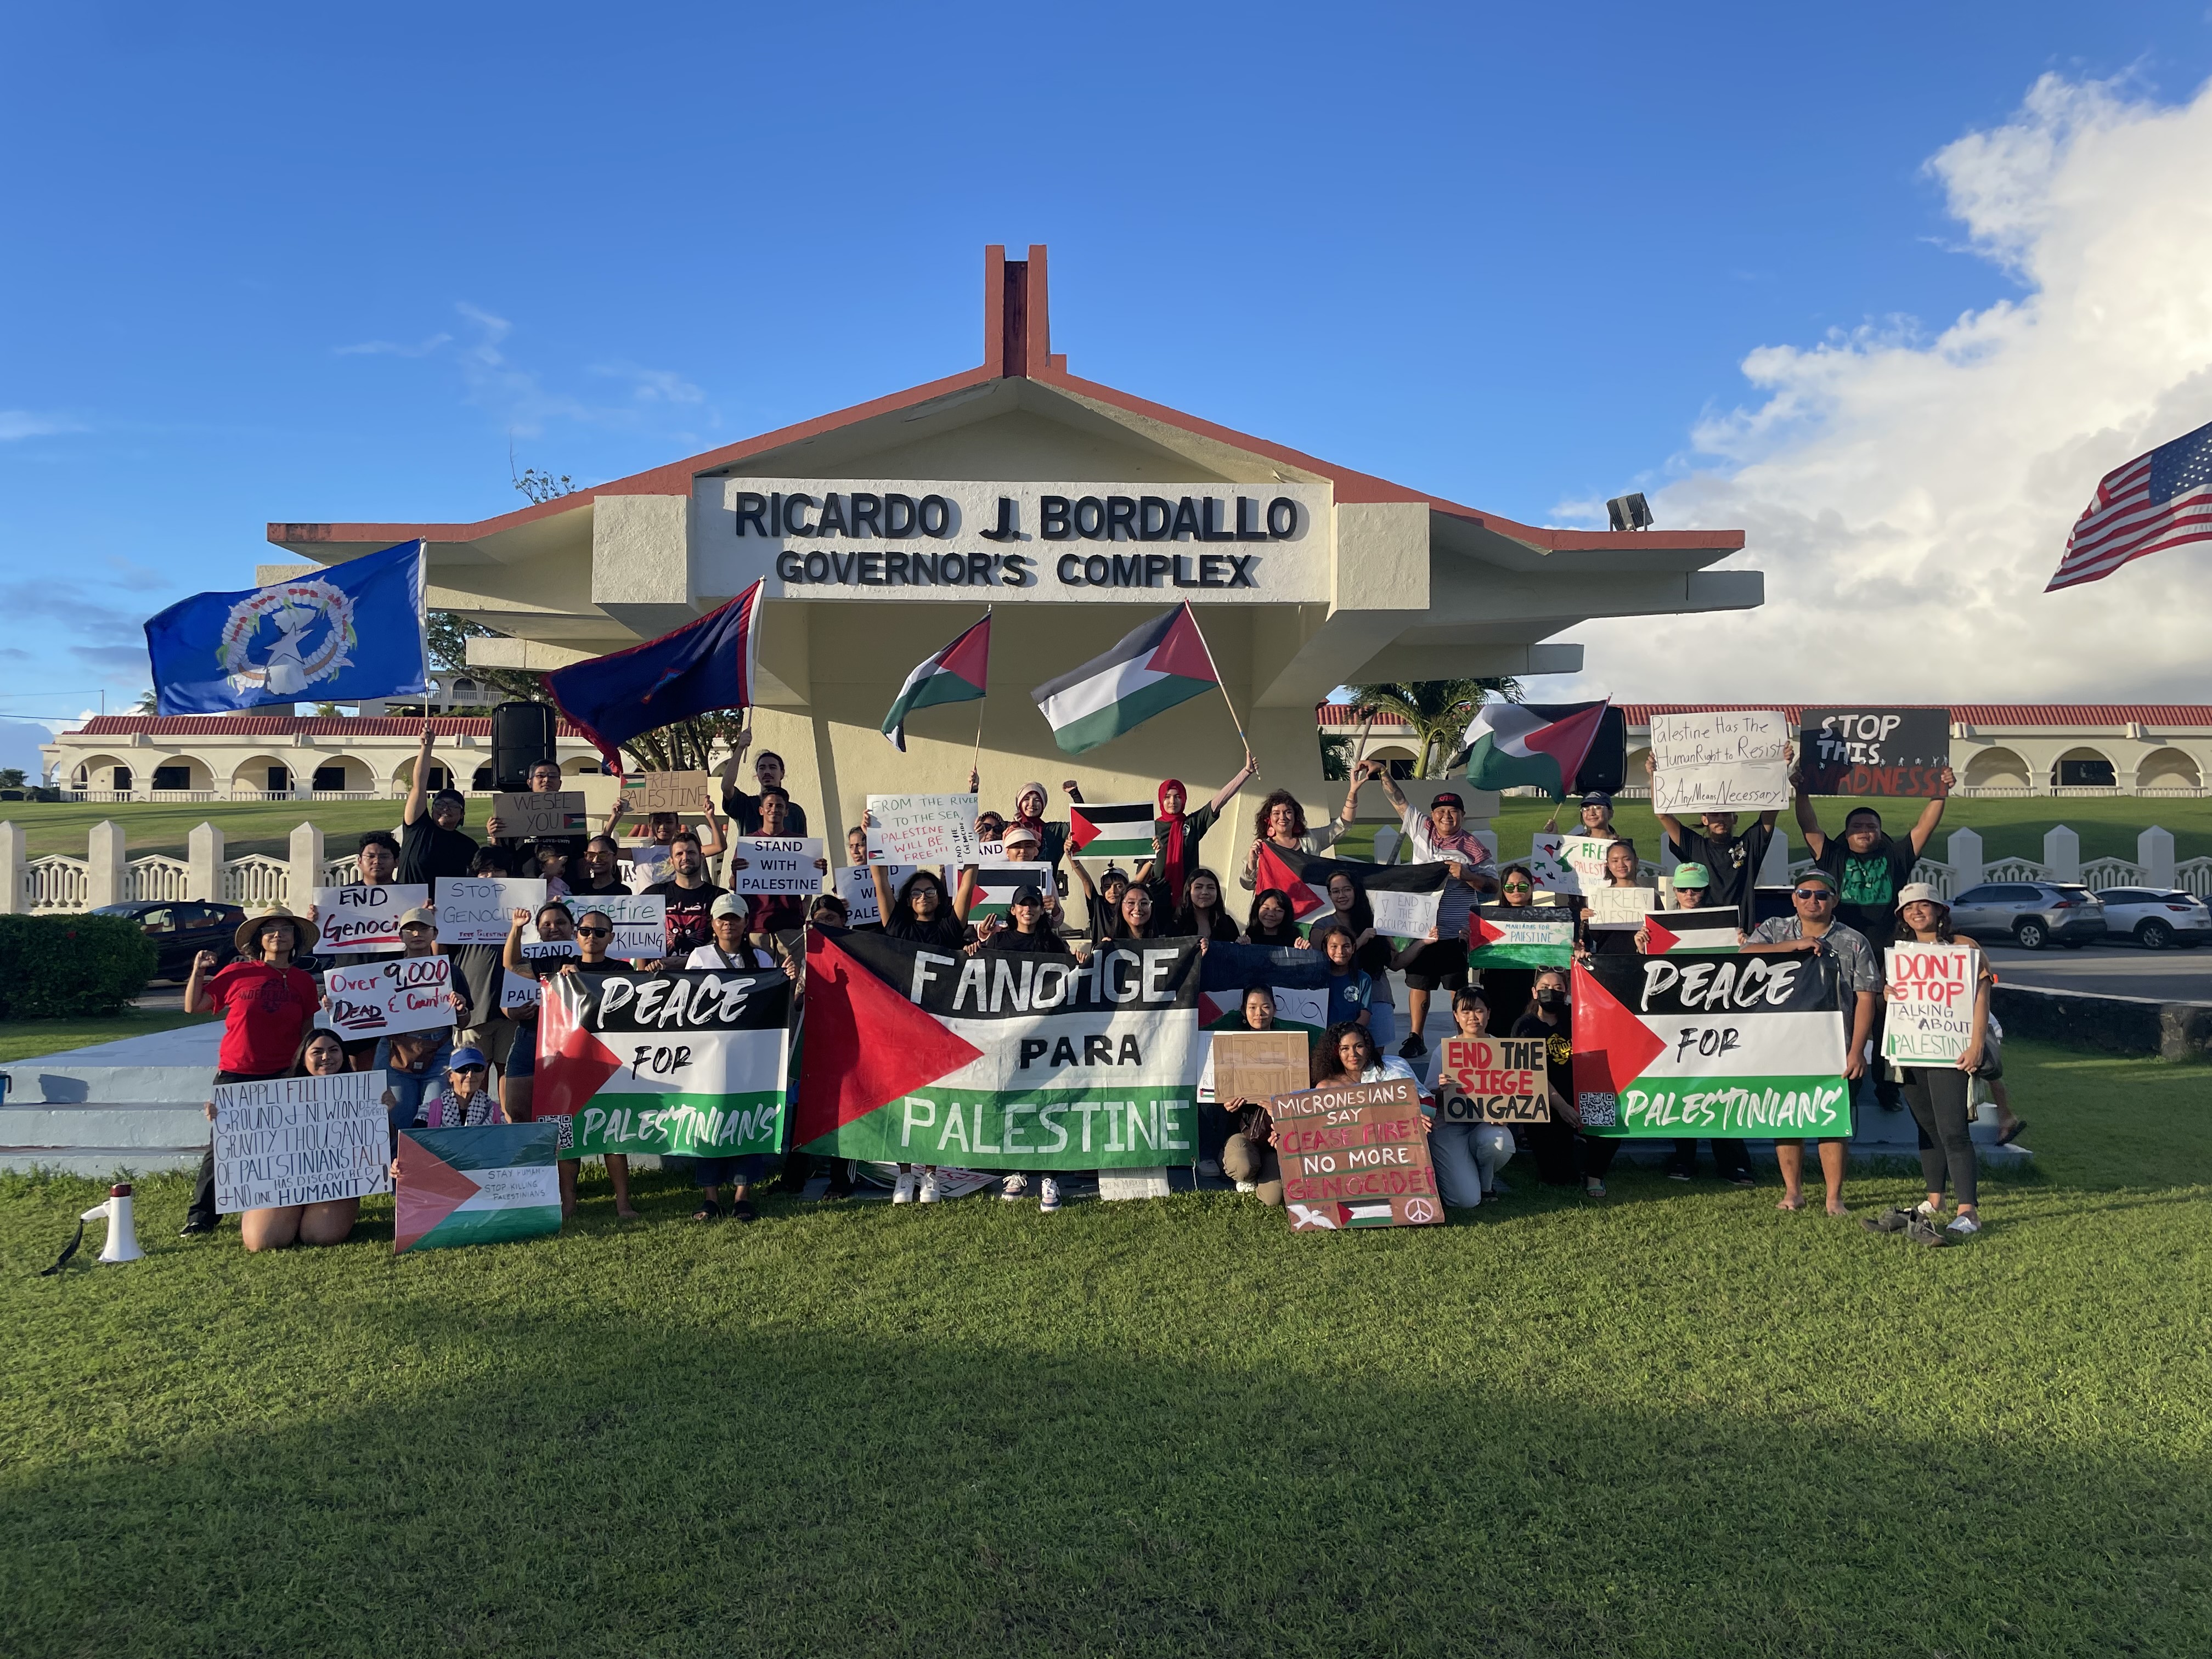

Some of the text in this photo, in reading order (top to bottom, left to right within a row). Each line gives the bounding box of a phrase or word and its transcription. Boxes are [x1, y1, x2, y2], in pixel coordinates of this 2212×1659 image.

[736, 492, 1297, 540] RICARDO J. BORDALLO
[776, 550, 1251, 586] GOVERNOR'S COMPLEX
[1652, 716, 1769, 744] Palestine Has The
[1819, 714, 1901, 741] STOP
[1655, 736, 1786, 769] Human Right to Resist
[1816, 740, 1880, 765] THIS
[645, 772, 679, 788] FREE
[1812, 765, 1948, 796] MADNESS!
[514, 793, 571, 811] WE SEE
[620, 786, 707, 808] PALESTINE
[1655, 776, 1674, 812] By
[1674, 778, 1692, 807] Any
[1692, 783, 1717, 802] Means
[872, 797, 978, 815] FROM THE RIVER
[526, 812, 559, 832] YOU
[891, 811, 963, 827] TO THE SEA,
[755, 840, 803, 851] STAND
[881, 826, 945, 844] PALESTINE
[894, 835, 944, 853] WILL BE
[951, 827, 964, 864] END THE
[1582, 843, 1609, 860] FRE
[760, 860, 797, 870] WITH
[854, 865, 899, 880] STD
[450, 883, 507, 898] STOP
[742, 879, 818, 890] PALESTINE
[340, 888, 388, 907] END
[1398, 895, 1419, 906] END
[1601, 889, 1642, 909] FREE
[563, 899, 656, 920] Ceasefire
[1398, 908, 1414, 919] THE
[1591, 910, 1644, 926] PALESTIN
[323, 914, 399, 941] Genoci
[477, 929, 508, 938] PALESTINE
[1376, 918, 1432, 933] OCCUPATION
[1511, 931, 1554, 943] PALESTINE
[523, 945, 573, 958] STAND
[616, 932, 664, 953] KILLING
[331, 959, 449, 992] Over 9,000
[1895, 952, 1967, 980] DON'T
[1640, 957, 1802, 1012] PEACE
[1893, 981, 1965, 1008] STOP
[333, 1000, 382, 1023] DEAD
[596, 975, 756, 1029] PEACE
[1890, 1002, 1954, 1018] TALKING
[1918, 1017, 1971, 1034] ABOUT
[1020, 1035, 1142, 1069] PARA
[1449, 1041, 1544, 1071] END THE
[1677, 1028, 1741, 1064] FOR
[632, 1046, 693, 1080] FOR
[215, 1073, 379, 1109] AN APPLE FELL TO THE
[1456, 1069, 1533, 1095] SIEGE
[358, 1107, 388, 1118] COVERED
[1277, 1085, 1408, 1118] MICRONESIANS
[1447, 1093, 1549, 1120] ON GAZA
[1624, 1086, 1842, 1131] PALESTINIANS
[216, 1105, 283, 1135] GROUND
[306, 1101, 358, 1123] NEWTON
[582, 1103, 781, 1149] PALESTINIANS
[901, 1097, 1190, 1153] PALESTINE
[1327, 1108, 1363, 1125] SAY
[280, 1117, 390, 1152] THOUSANDS
[1283, 1116, 1419, 1154] CEASE FIRE!
[217, 1144, 387, 1186] OF PALESTINIANS FALL
[1304, 1148, 1411, 1175] NO MORE
[274, 1167, 374, 1190] HAS DISCOVERED
[488, 1169, 513, 1180] STAY
[1286, 1166, 1437, 1200] GENOCIDE!
[234, 1184, 252, 1209] NO
[255, 1191, 274, 1205] ONE
[484, 1180, 538, 1193] STOP KILLING
[493, 1189, 545, 1200] PALESTINIANS
